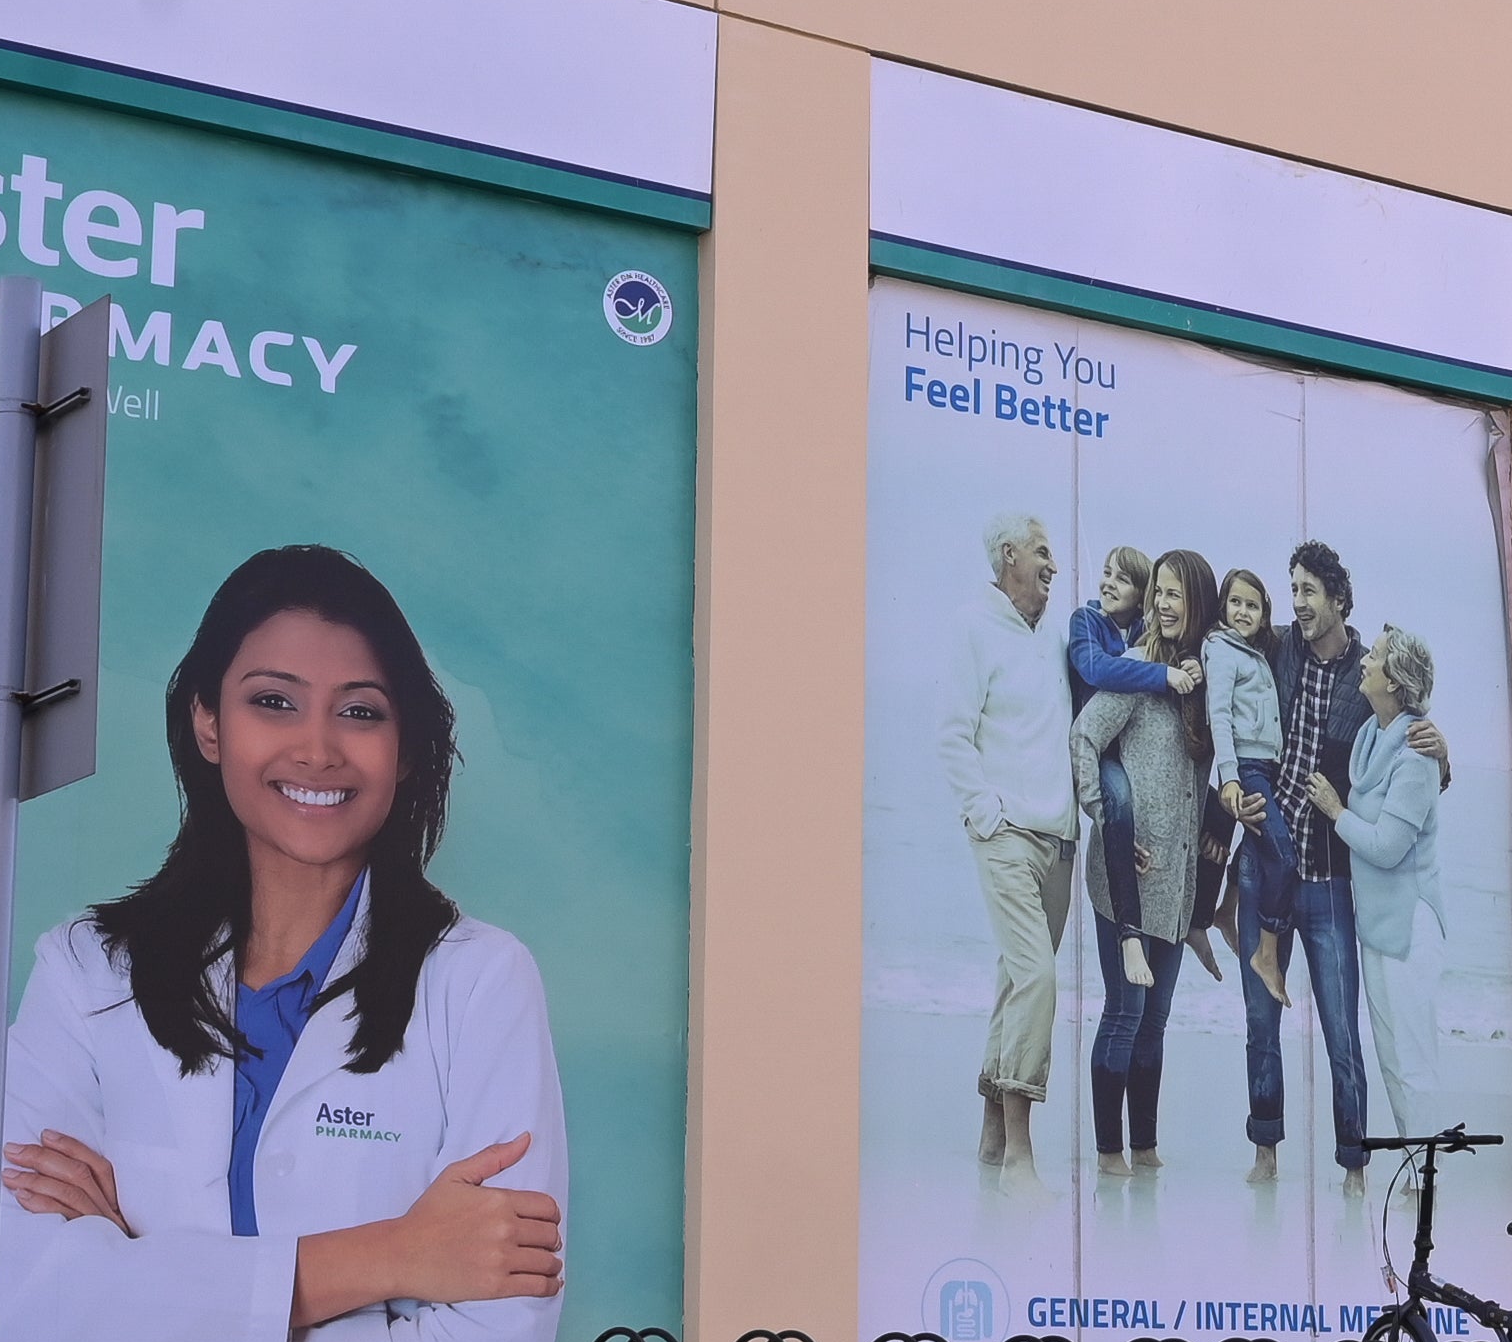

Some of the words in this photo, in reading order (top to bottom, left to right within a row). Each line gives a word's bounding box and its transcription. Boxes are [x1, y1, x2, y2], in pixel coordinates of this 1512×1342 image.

[906, 312, 1044, 385] Helping
[1054, 342, 1116, 389] You
[906, 365, 981, 415] Feel
[996, 384, 1110, 438] Better
[316, 1102, 375, 1126] Aster
[315, 1126, 402, 1142] PHARMACY
[1027, 1297, 1165, 1329] GENERAL
[1173, 1300, 1187, 1330] /
[1196, 1301, 1332, 1332] INTERNAL
[1340, 1305, 1470, 1335] MEINE
